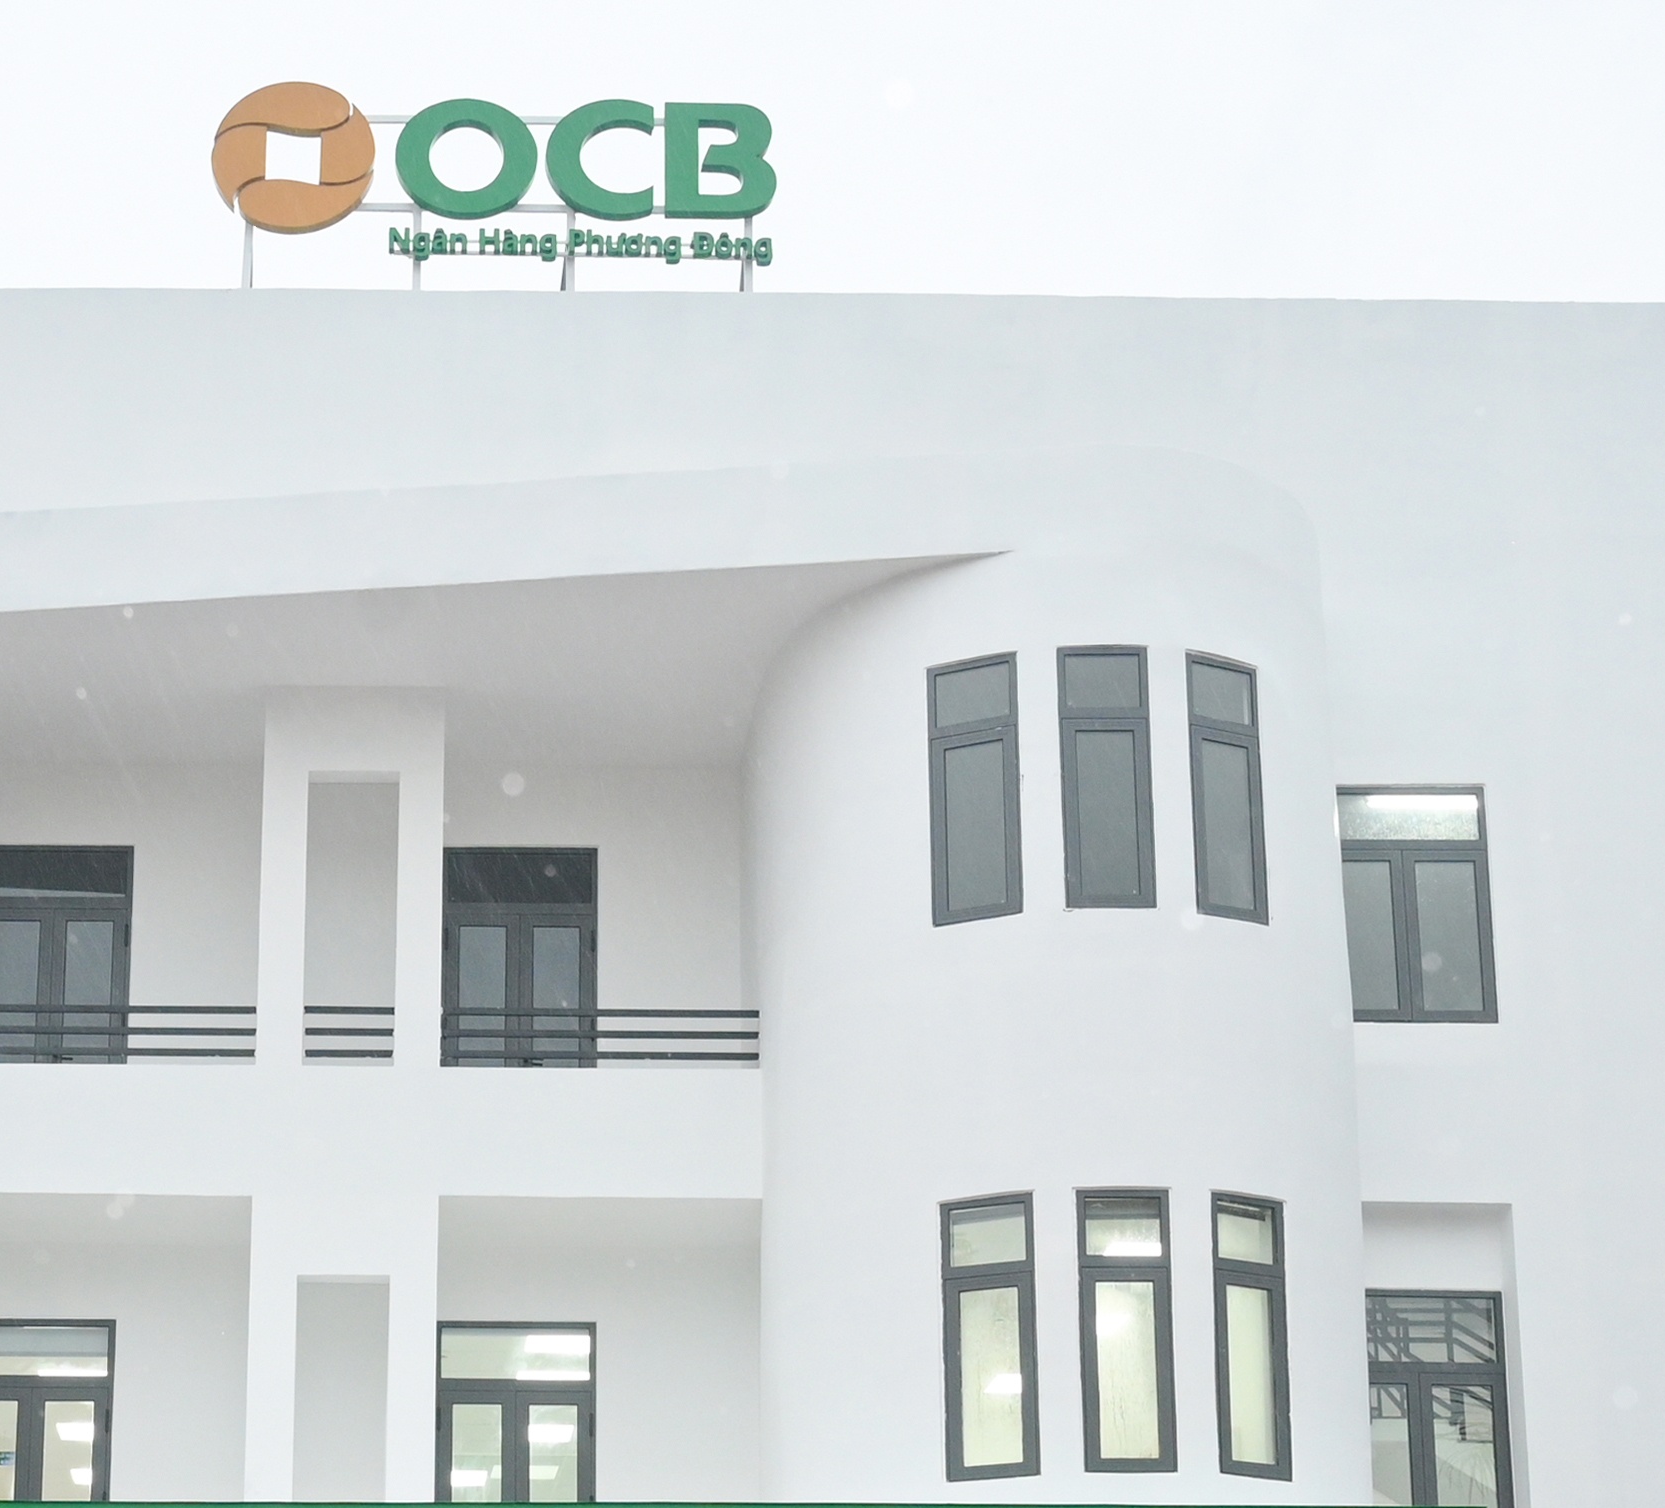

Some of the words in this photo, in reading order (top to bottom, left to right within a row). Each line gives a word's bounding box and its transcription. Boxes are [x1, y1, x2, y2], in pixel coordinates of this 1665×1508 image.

[395, 98, 777, 220] OCB
[389, 227, 467, 261] Ngân
[479, 228, 557, 262] Hàng
[569, 229, 681, 264] Phương
[691, 232, 772, 266] Đông
